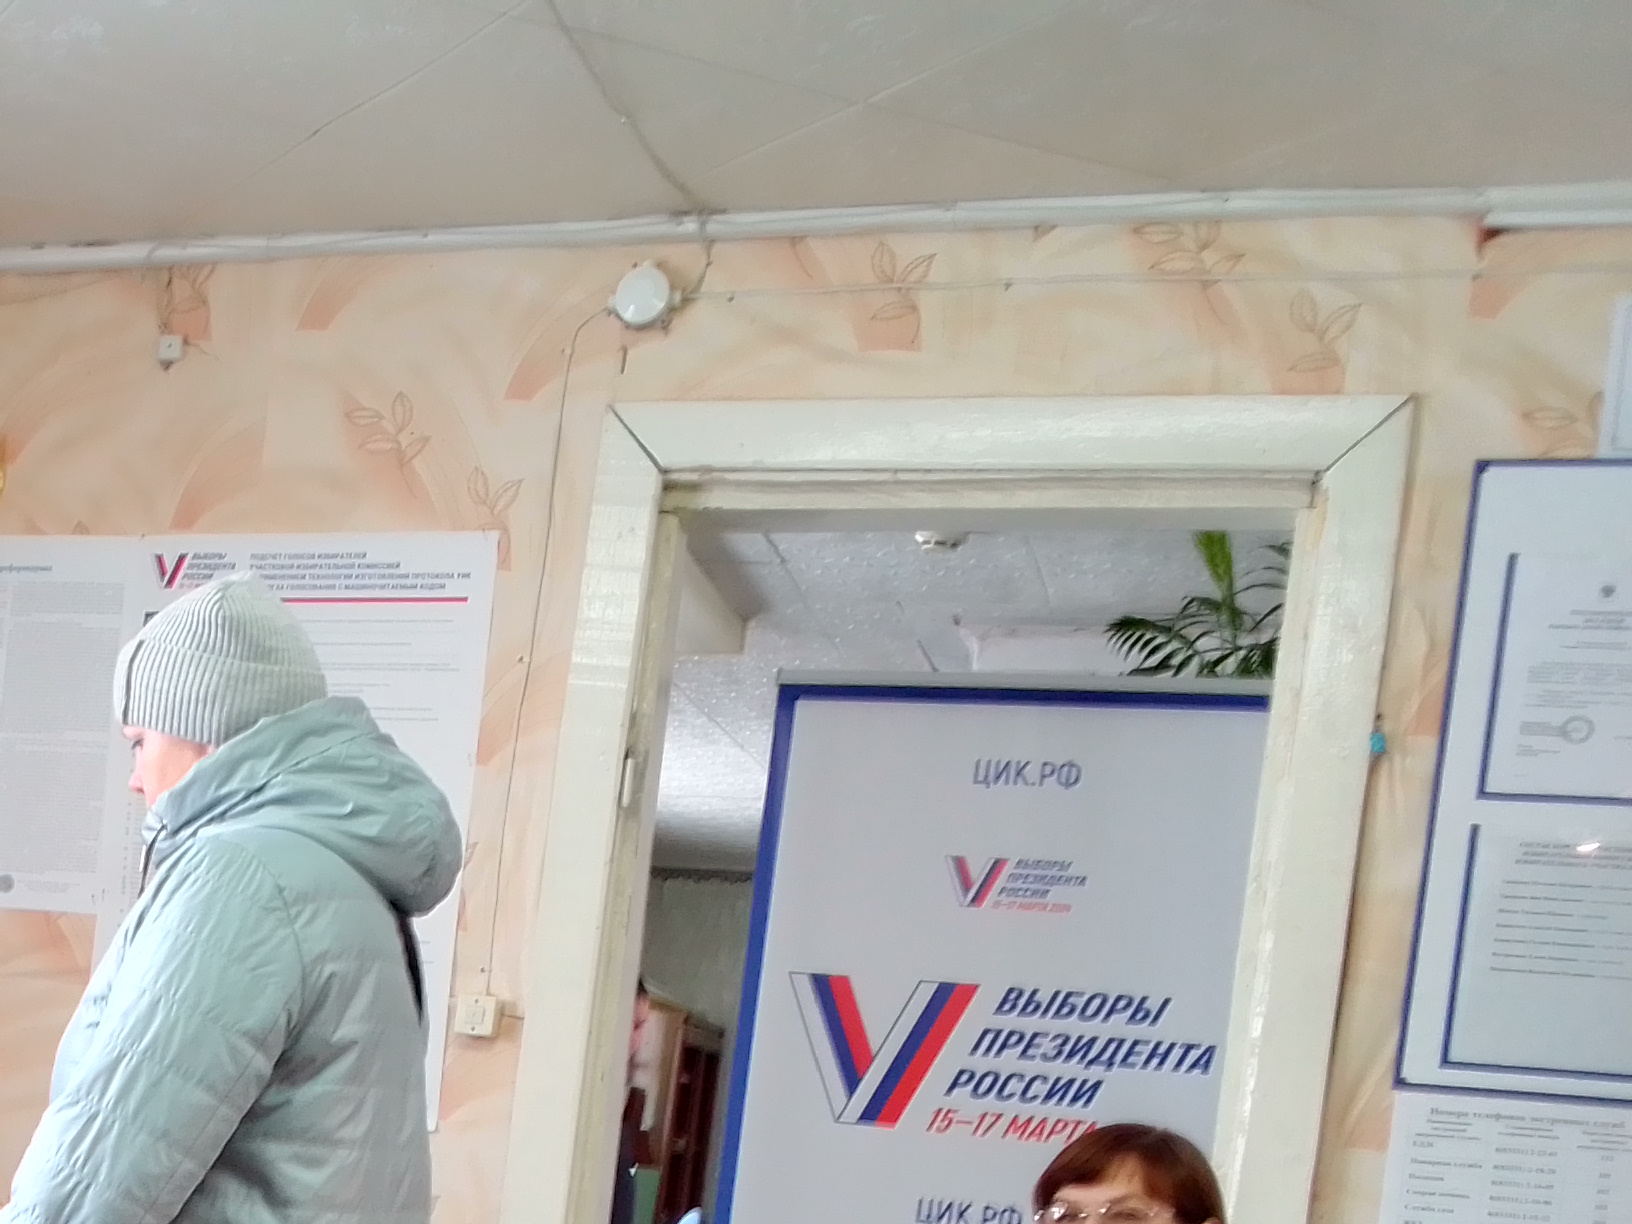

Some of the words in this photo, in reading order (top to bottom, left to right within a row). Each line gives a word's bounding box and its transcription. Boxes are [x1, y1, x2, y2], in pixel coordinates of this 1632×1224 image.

[973, 758, 1082, 790] ЦИК.РФ
[1006, 872, 1088, 887] ПРЕЗИДЕНТА
[1013, 858, 1074, 872] ВЫБОРЫ
[997, 886, 1052, 899] РОССИИ
[991, 985, 1172, 1029] ВЫБОРЫ
[968, 1027, 1218, 1076] ПРЕЗИДЕНТА
[944, 1067, 1105, 1110] РОССИИ
